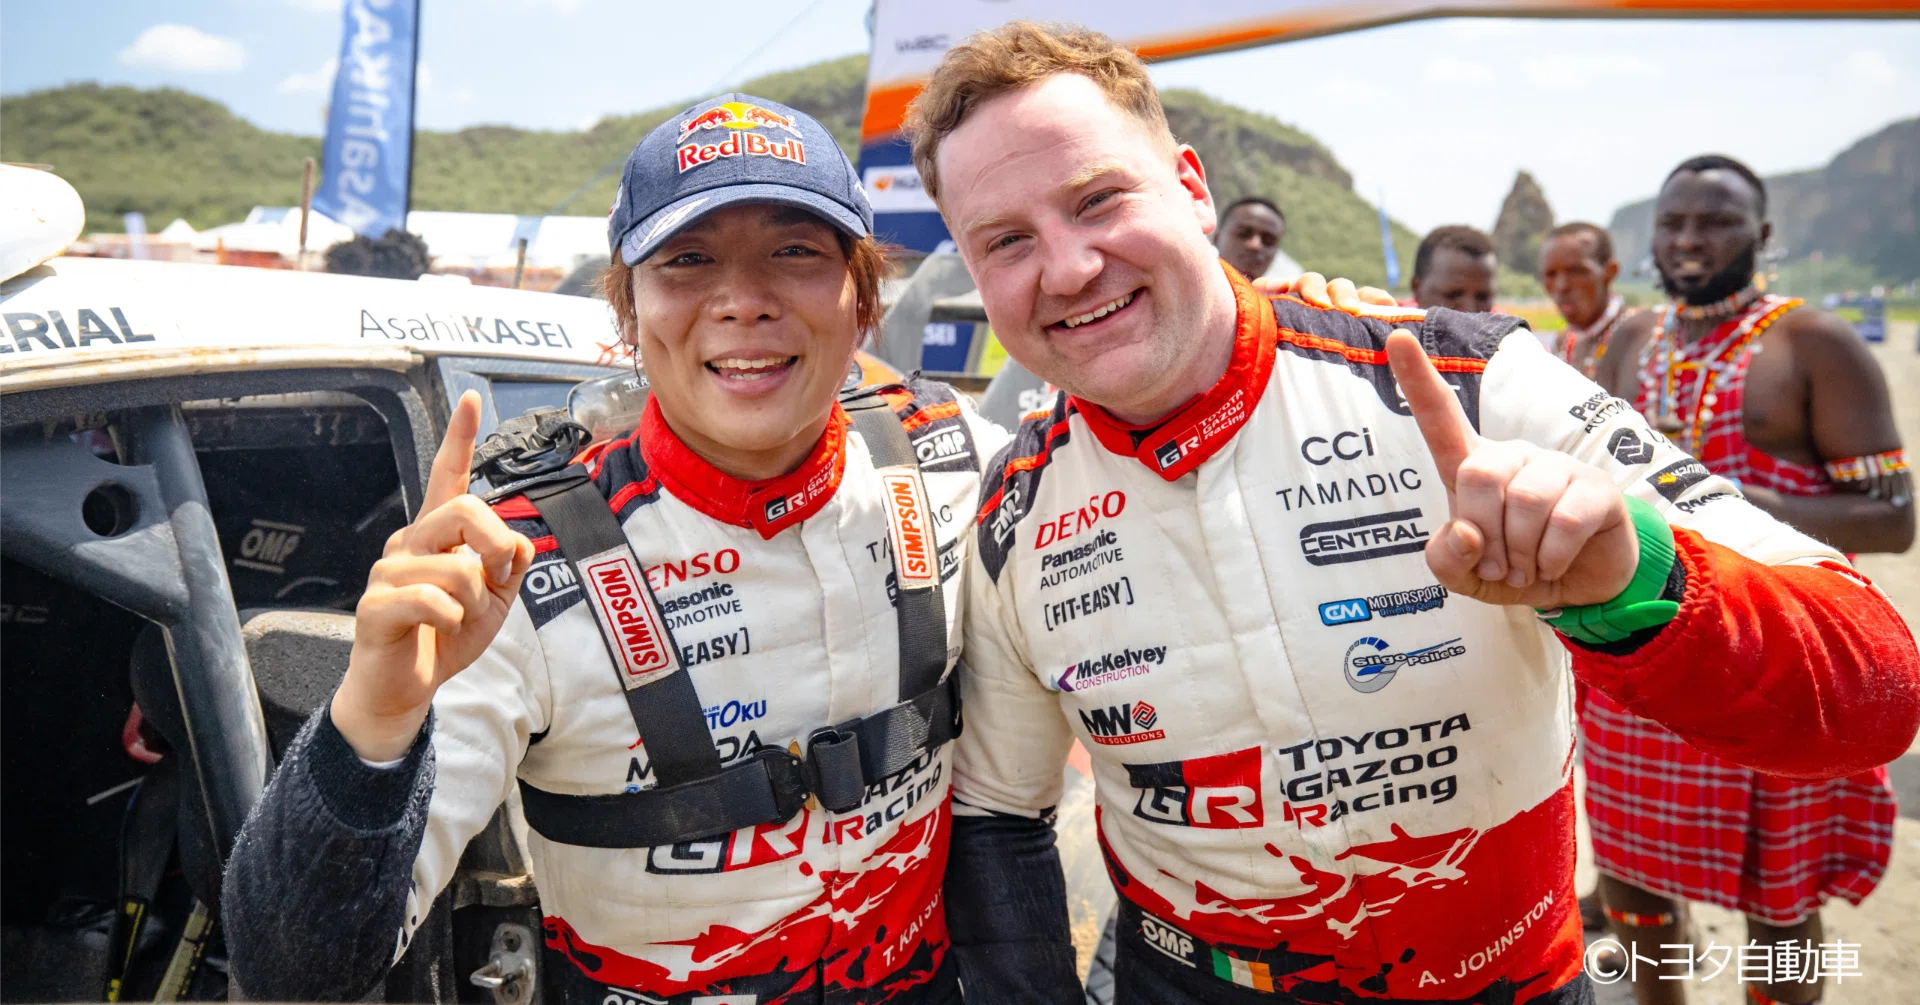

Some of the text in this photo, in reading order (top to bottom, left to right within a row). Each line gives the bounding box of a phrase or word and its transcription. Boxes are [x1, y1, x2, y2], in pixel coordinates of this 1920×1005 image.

[677, 131, 807, 174] Red Bull
[359, 308, 573, 348] AsahiKASEI
[1199, 389, 1244, 427] TOYOTA
[1203, 400, 1244, 435] GAZOO
[1204, 410, 1245, 440] Racing
[916, 430, 966, 462] OMP
[1160, 434, 1200, 469] GR
[766, 491, 805, 521] GR
[1276, 468, 1422, 511] TAMADIC
[891, 482, 926, 573] SIMPSON
[1034, 490, 1127, 550] DENSO
[1300, 522, 1430, 555] CENTRAL
[240, 528, 301, 563] OMP
[1041, 530, 1117, 572] Panasonic
[526, 562, 577, 595] OM
[643, 548, 740, 593] ENSO
[1040, 548, 1124, 590] AUTOMOTIVE
[597, 567, 660, 667] SIMPSON
[1368, 584, 1448, 611] MOTORSPORT
[1076, 645, 1167, 680] McKelvey
[1353, 645, 1466, 668] Sligo Pallets
[1075, 664, 1150, 691] CONSTRUCTION
[1108, 731, 1163, 745] SOLUTIONS
[1279, 713, 1472, 772] TOYOTA
[1280, 745, 1458, 802] GAZOO
[822, 760, 943, 846] Racing
[1132, 779, 1262, 829] GR
[1283, 774, 1458, 830] Racing
[645, 808, 808, 873] GR
[882, 945, 896, 967] T.
[1141, 919, 1195, 958] OMP
[1418, 889, 1554, 988] A. JOHNSTON
